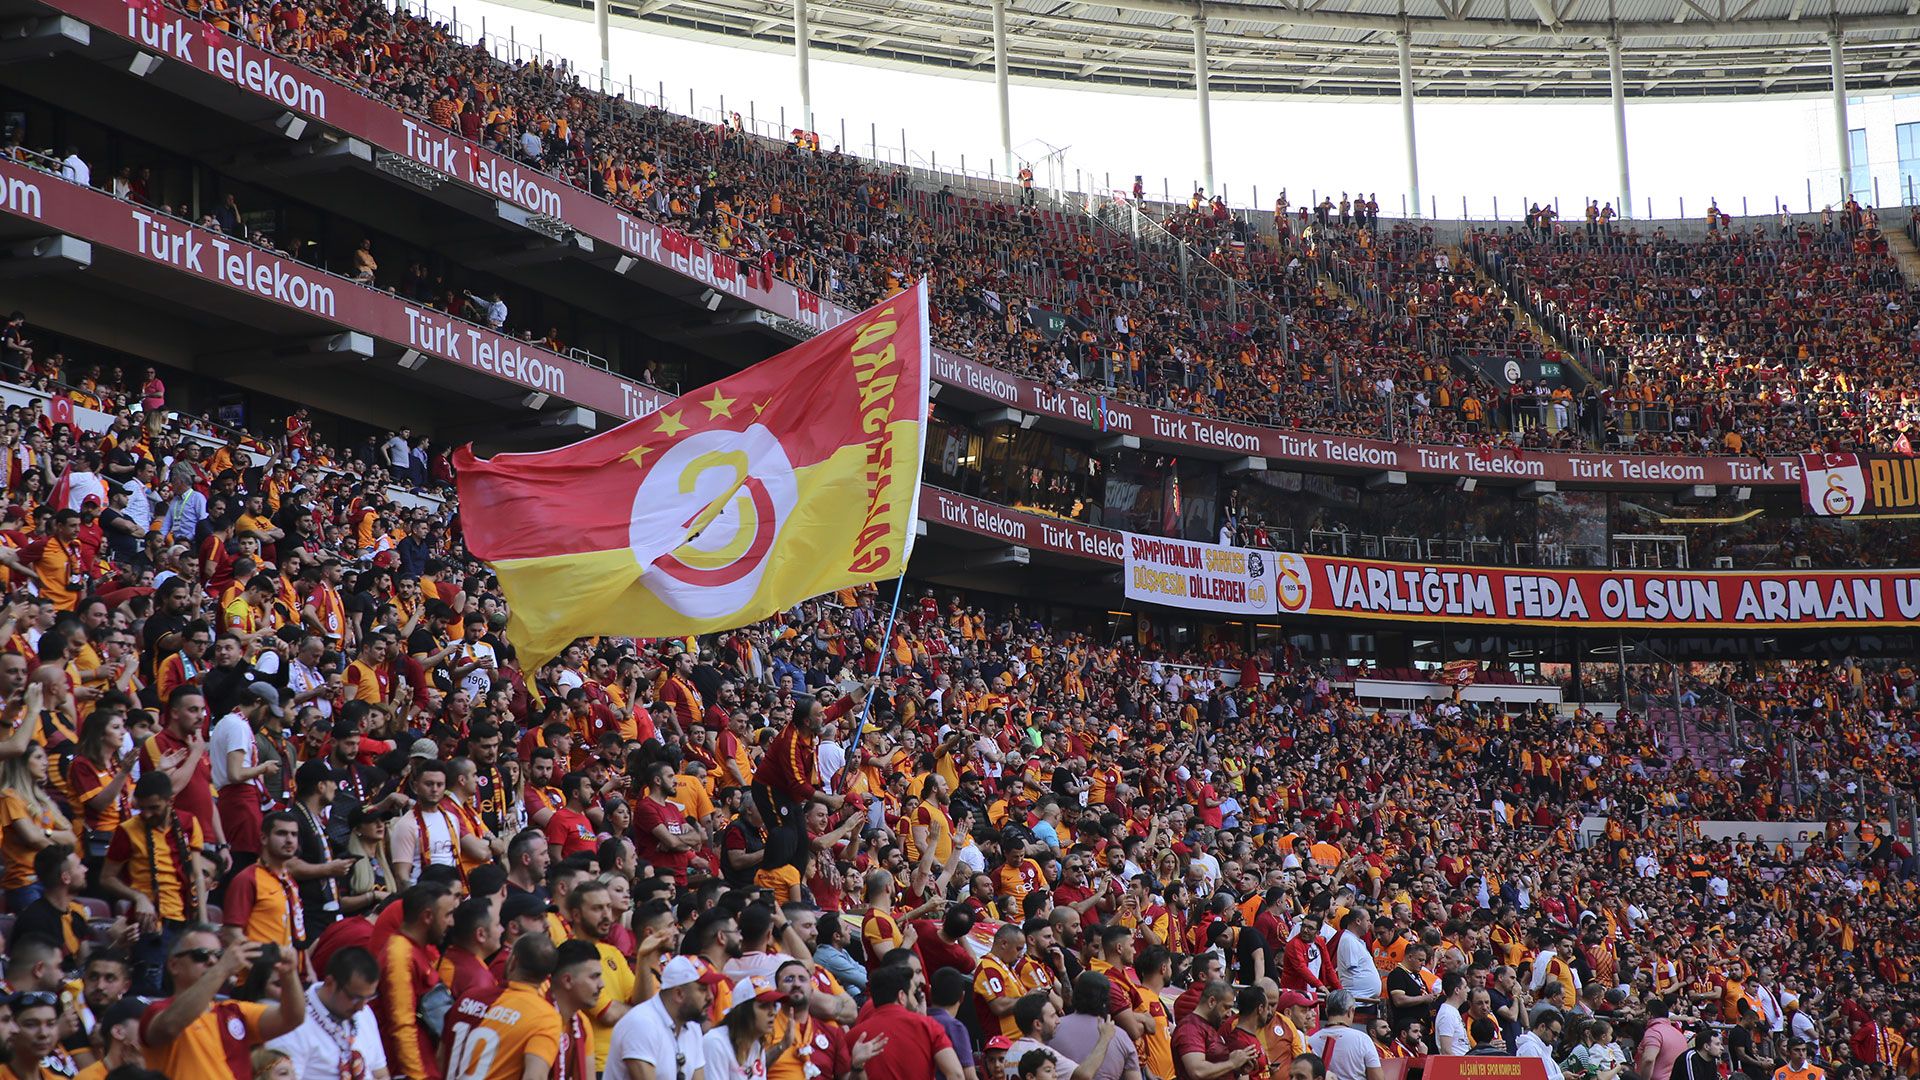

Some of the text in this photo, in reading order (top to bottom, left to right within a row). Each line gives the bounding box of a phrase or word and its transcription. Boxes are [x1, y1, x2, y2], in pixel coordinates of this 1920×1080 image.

[402, 118, 458, 176] Türk
[616, 212, 662, 263] Türk
[132, 211, 335, 317] Türk Telekom
[404, 306, 565, 394] Türk Telekom
[933, 353, 1018, 403] Türk Telekom
[1033, 387, 1132, 430] Türk Telom
[1151, 415, 1260, 452] Türk Telekom
[1278, 435, 1397, 466] Türk Telekom
[1417, 449, 1545, 476] Türk Telekom
[1568, 458, 1704, 480] Türk Telekom
[1727, 461, 1775, 480] Türk
[938, 496, 1026, 540] Türk Telekom
[1040, 523, 1074, 550] Türk
[1131, 536, 1203, 570] ŞAMPİYONLUK
[1133, 565, 1246, 604] DÜŞMESİN DİLLERDEN
[1325, 565, 1496, 617] VARLIĞIM
[1503, 575, 1589, 620] FEDA
[1599, 578, 1723, 621] OLSUN
[1735, 578, 1884, 621] ARMAN
[982, 977, 1002, 994] 10
[446, 1020, 500, 1080] 10
